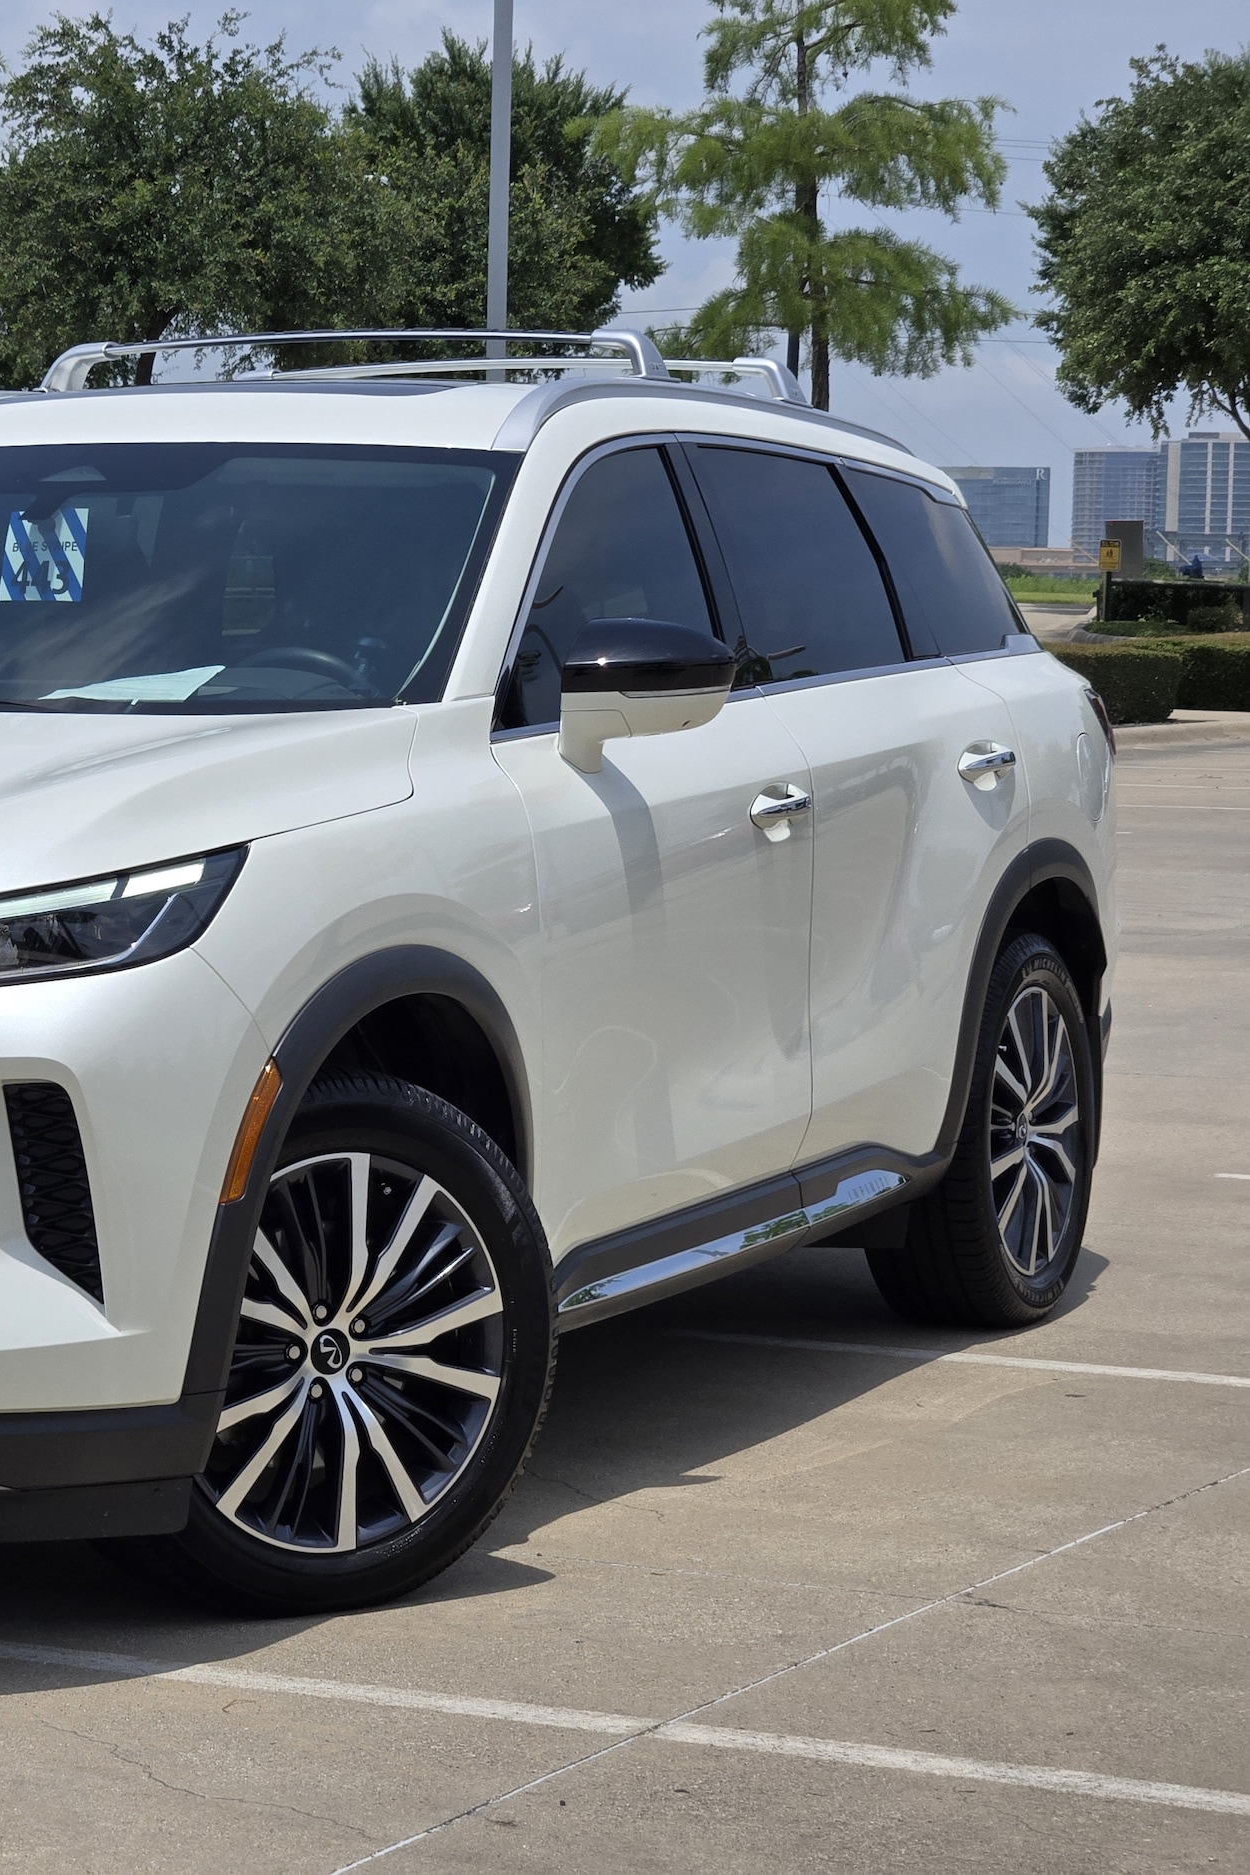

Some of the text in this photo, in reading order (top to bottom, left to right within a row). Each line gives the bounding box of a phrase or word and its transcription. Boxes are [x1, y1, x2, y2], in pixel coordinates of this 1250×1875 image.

[1035, 468, 1047, 480] R
[12, 541, 78, 552] BE SIPE
